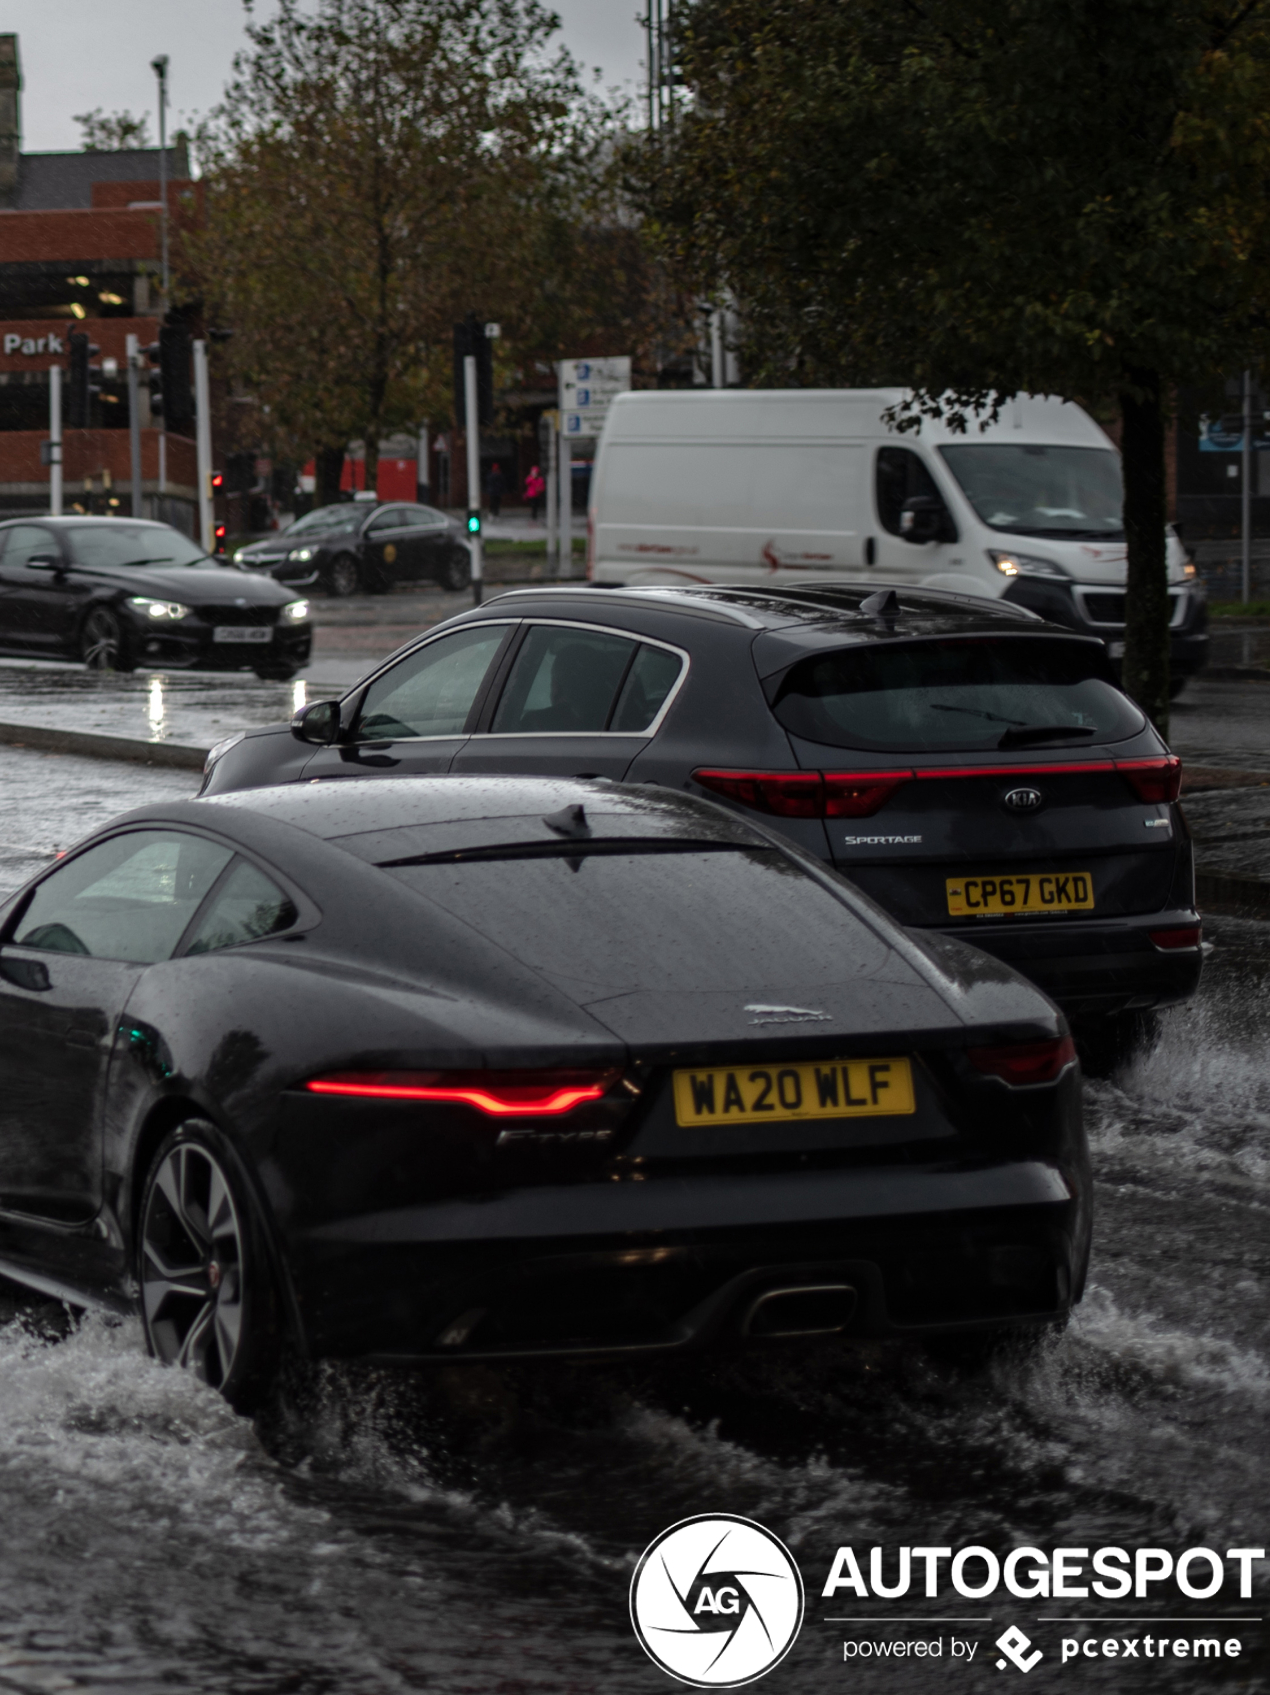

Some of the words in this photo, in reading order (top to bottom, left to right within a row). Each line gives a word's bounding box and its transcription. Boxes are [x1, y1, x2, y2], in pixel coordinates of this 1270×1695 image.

[3, 332, 65, 355] Park
[1012, 792, 1037, 807] KIA
[844, 834, 923, 846] SPORTAGE
[962, 878, 1030, 908] CP67
[1039, 875, 1090, 905] GKD
[747, 1014, 834, 1026] JAGUAR
[689, 1069, 802, 1116] WA20
[813, 1063, 891, 1109] WLF
[495, 1129, 613, 1146] F-TYPE
